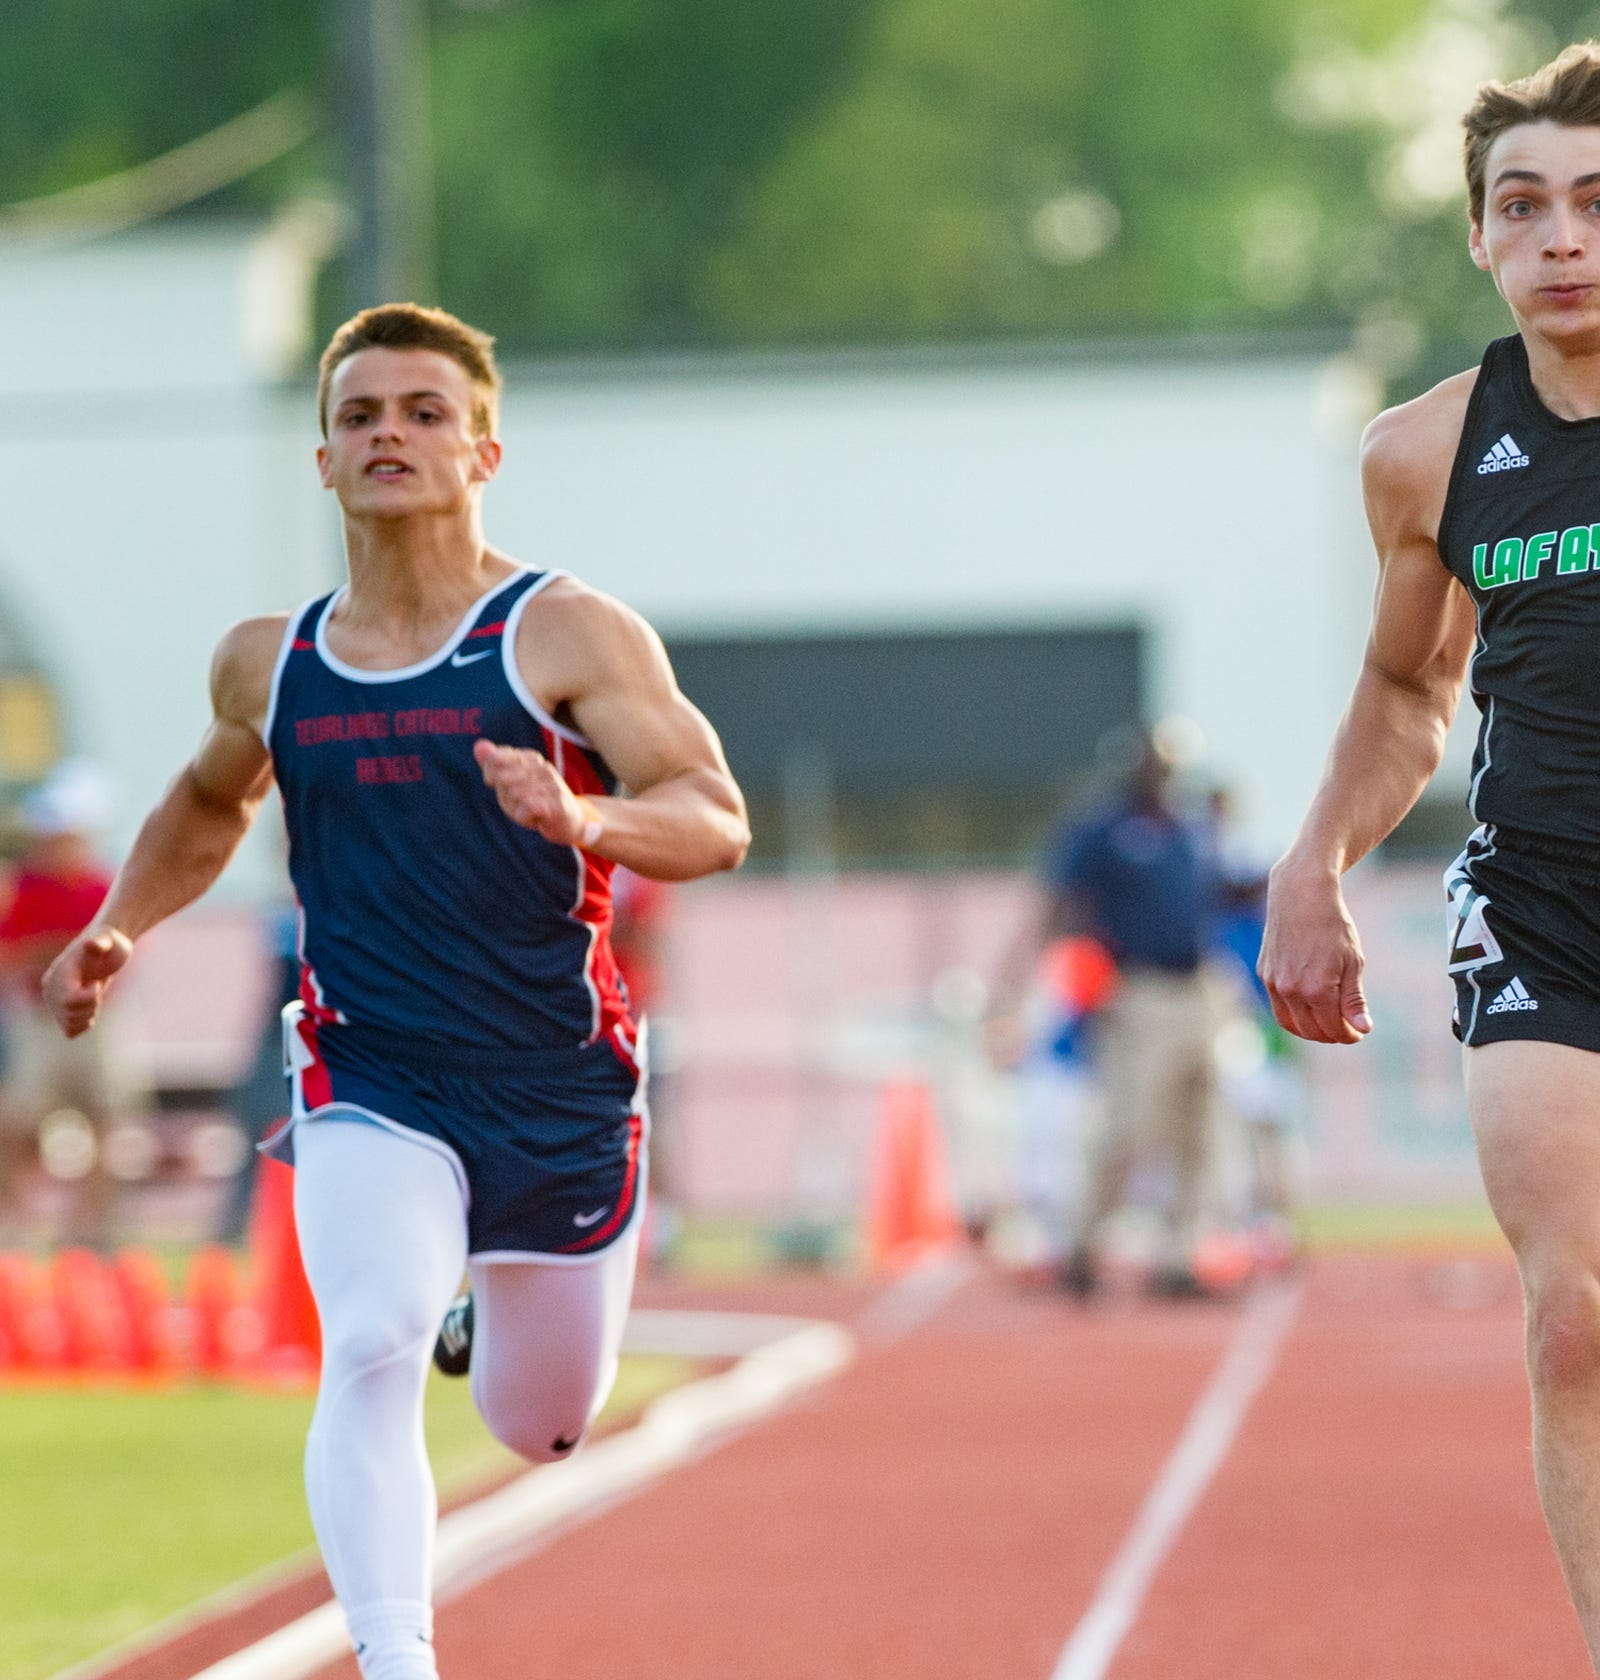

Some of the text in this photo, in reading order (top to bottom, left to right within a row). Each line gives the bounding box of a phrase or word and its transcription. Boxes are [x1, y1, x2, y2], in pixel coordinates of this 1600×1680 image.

[1477, 454, 1529, 474] adidas
[394, 708, 482, 737] CATHOLIC
[356, 756, 423, 784] REBELS
[1486, 999, 1538, 1015] adidas
